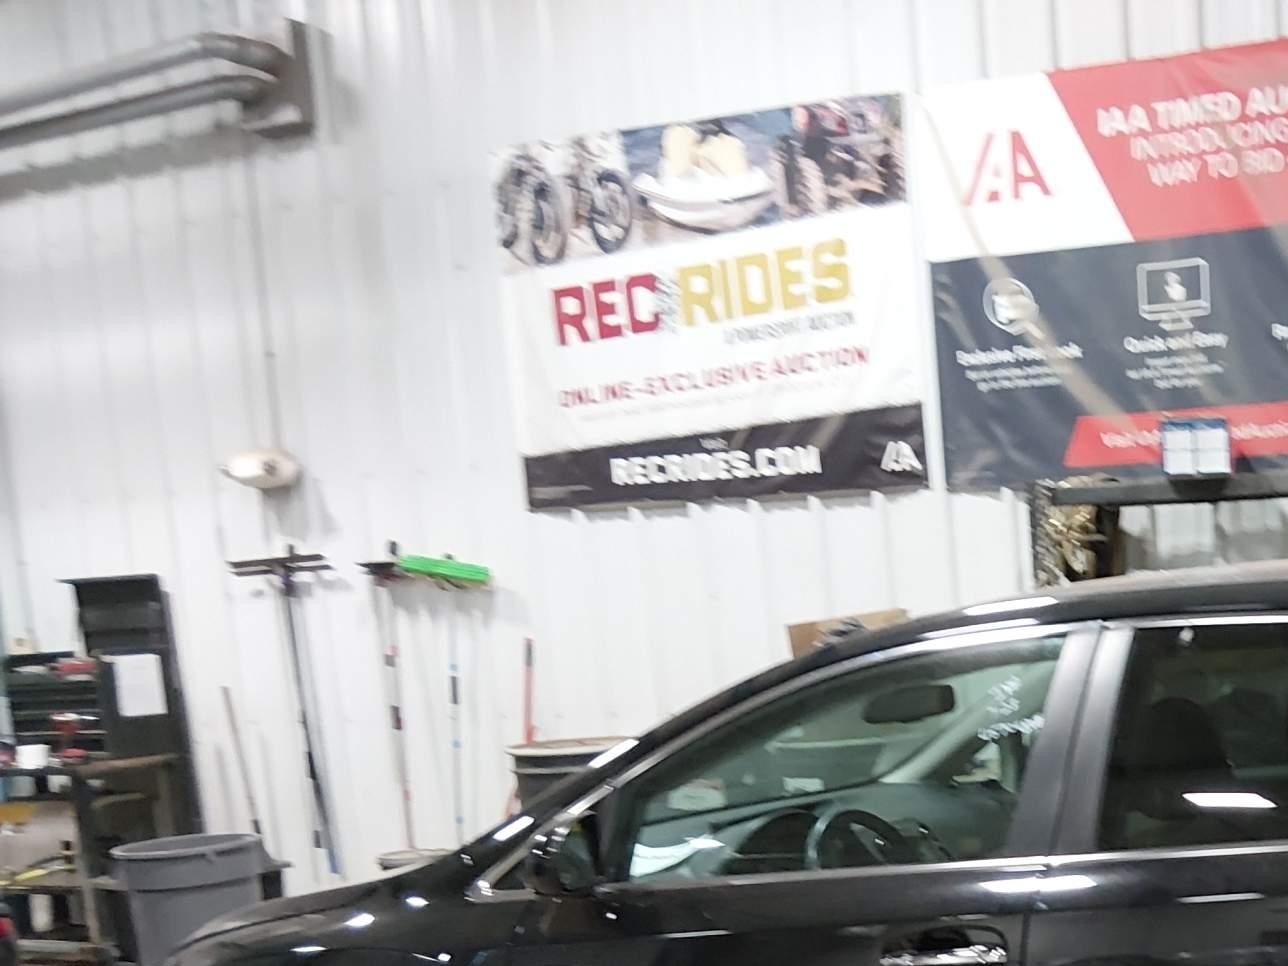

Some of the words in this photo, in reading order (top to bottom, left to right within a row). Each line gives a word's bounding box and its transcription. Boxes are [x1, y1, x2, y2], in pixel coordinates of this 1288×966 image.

[1151, 91, 1242, 128] TIMED
[1147, 157, 1202, 187] WAY
[1202, 152, 1239, 179] TO
[551, 272, 662, 347] REC
[677, 237, 851, 327] RIDES
[769, 344, 871, 378] AUCTION
[609, 444, 823, 486] RECRIDES.COM
